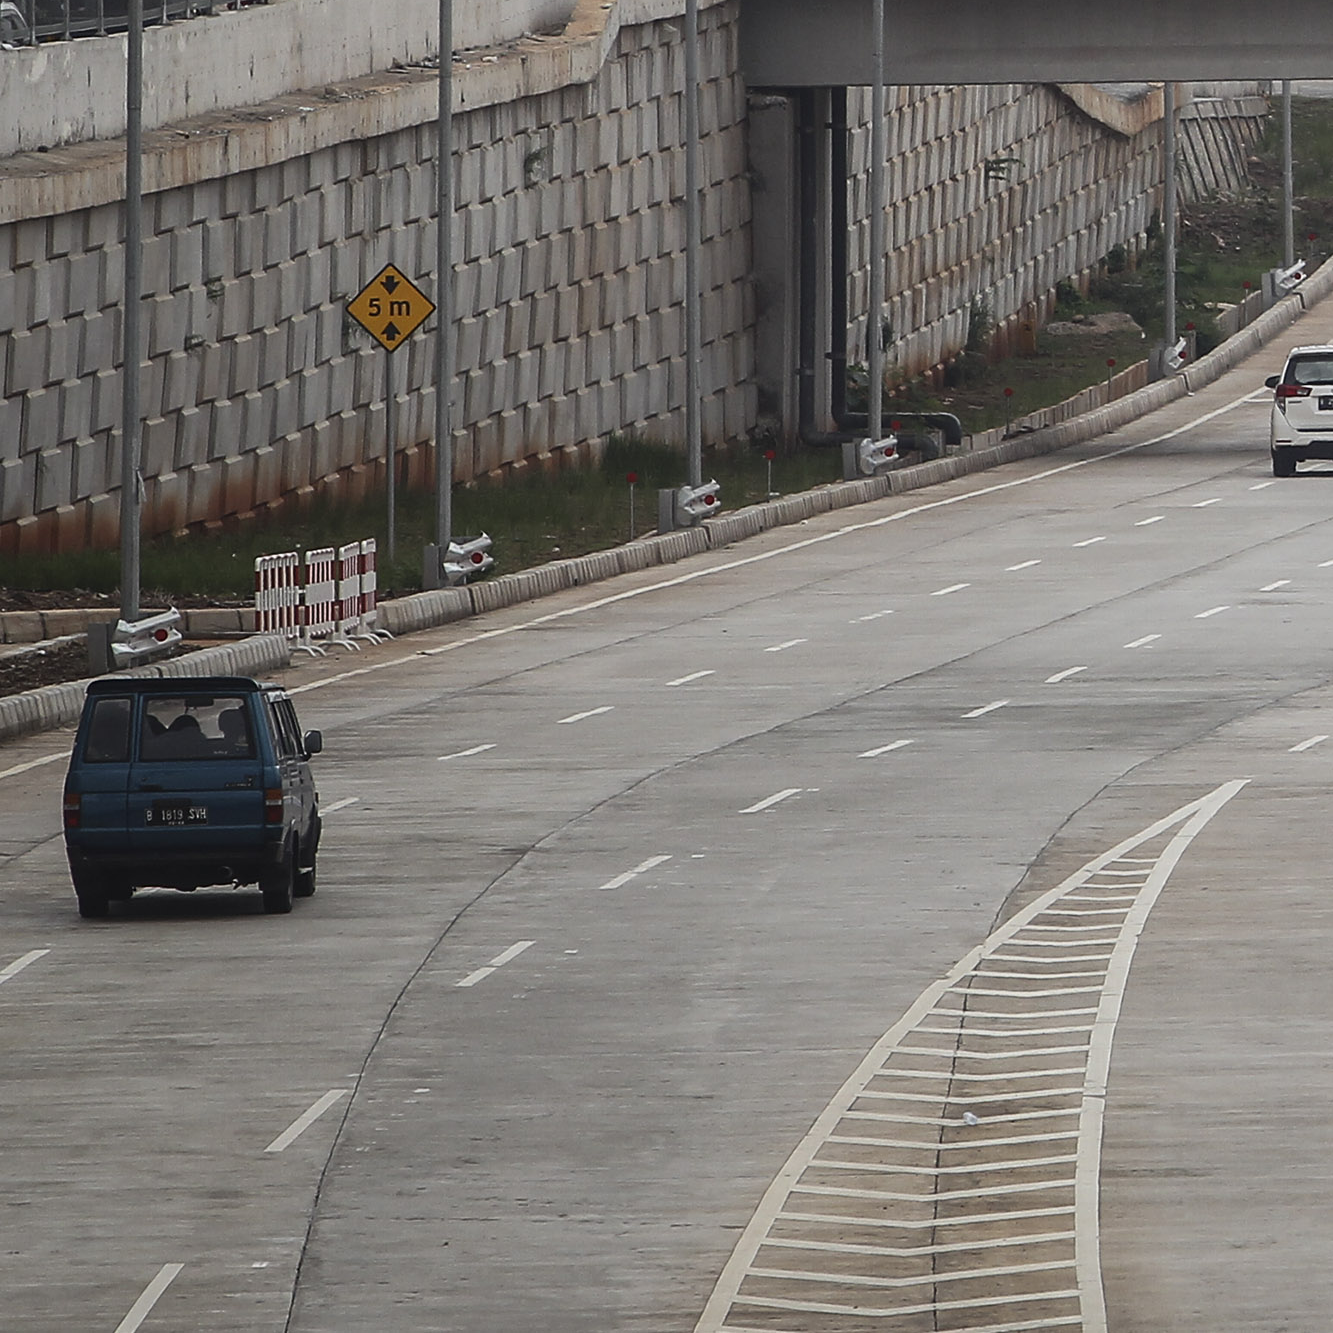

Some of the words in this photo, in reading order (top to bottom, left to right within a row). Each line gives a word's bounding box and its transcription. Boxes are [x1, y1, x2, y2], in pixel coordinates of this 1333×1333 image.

[368, 298, 381, 317] 5
[389, 300, 411, 316] m
[161, 809, 183, 820] 1819
